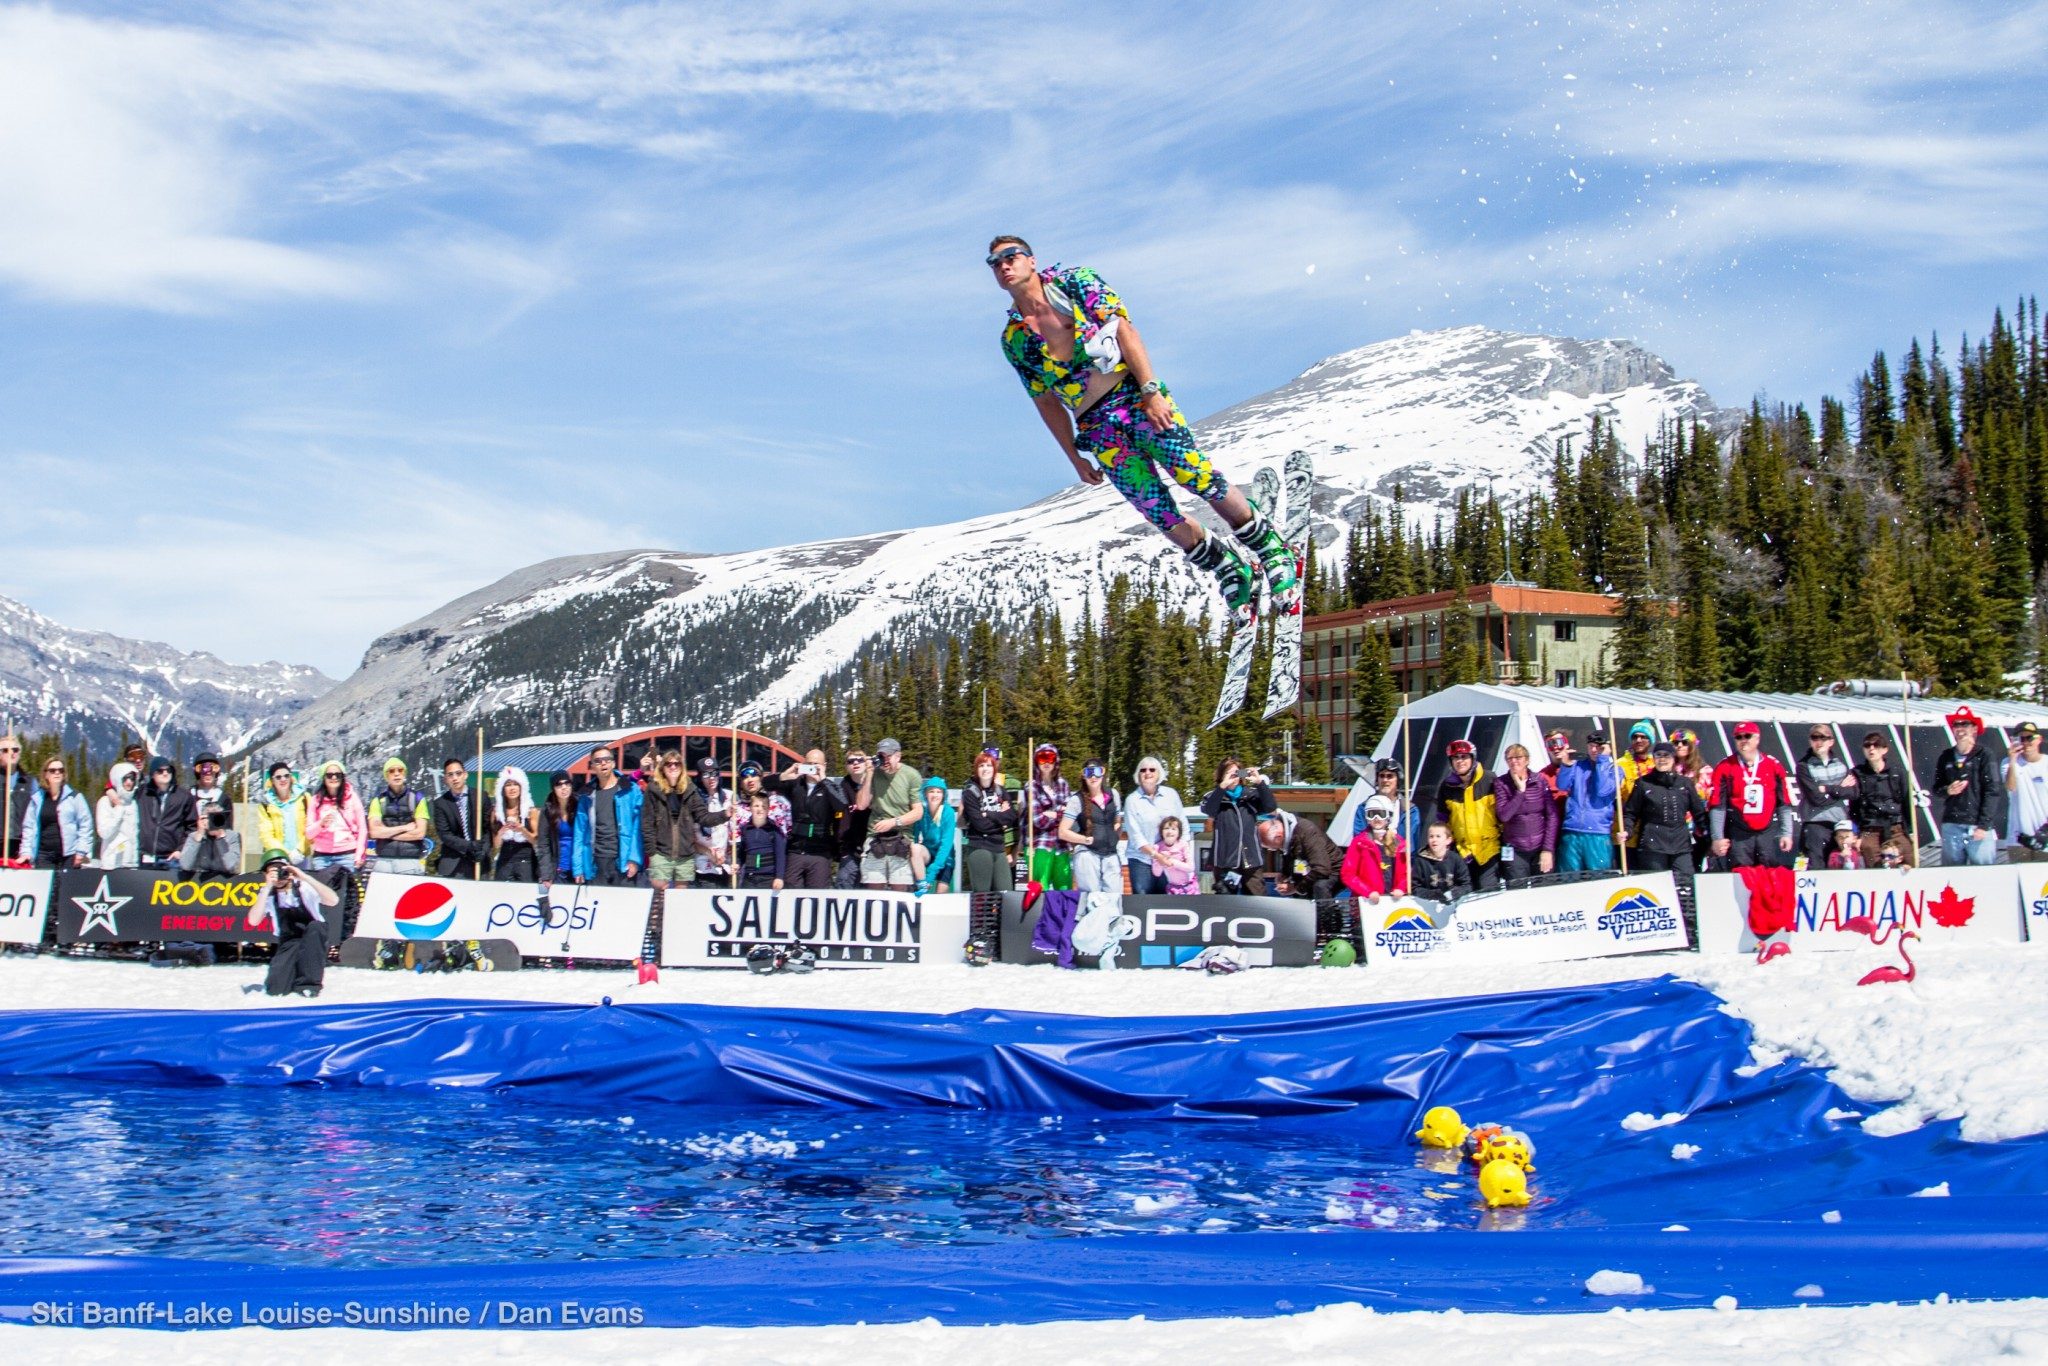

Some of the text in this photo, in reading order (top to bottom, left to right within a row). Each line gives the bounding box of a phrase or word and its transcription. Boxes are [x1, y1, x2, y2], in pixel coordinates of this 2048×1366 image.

[150, 880, 267, 906] ROCKS
[161, 915, 237, 931] ENERGY
[486, 900, 599, 935] pepsi
[708, 895, 922, 943] SALOMON
[1456, 910, 1585, 932] SUNSHINE VILLAGE
[1598, 907, 1670, 931] SUNSHINE
[1491, 927, 1548, 940] Snowboard
[1552, 923, 1588, 933] Resort
[1610, 918, 1677, 940] VILLAGE
[710, 942, 917, 962] SNWOARDS
